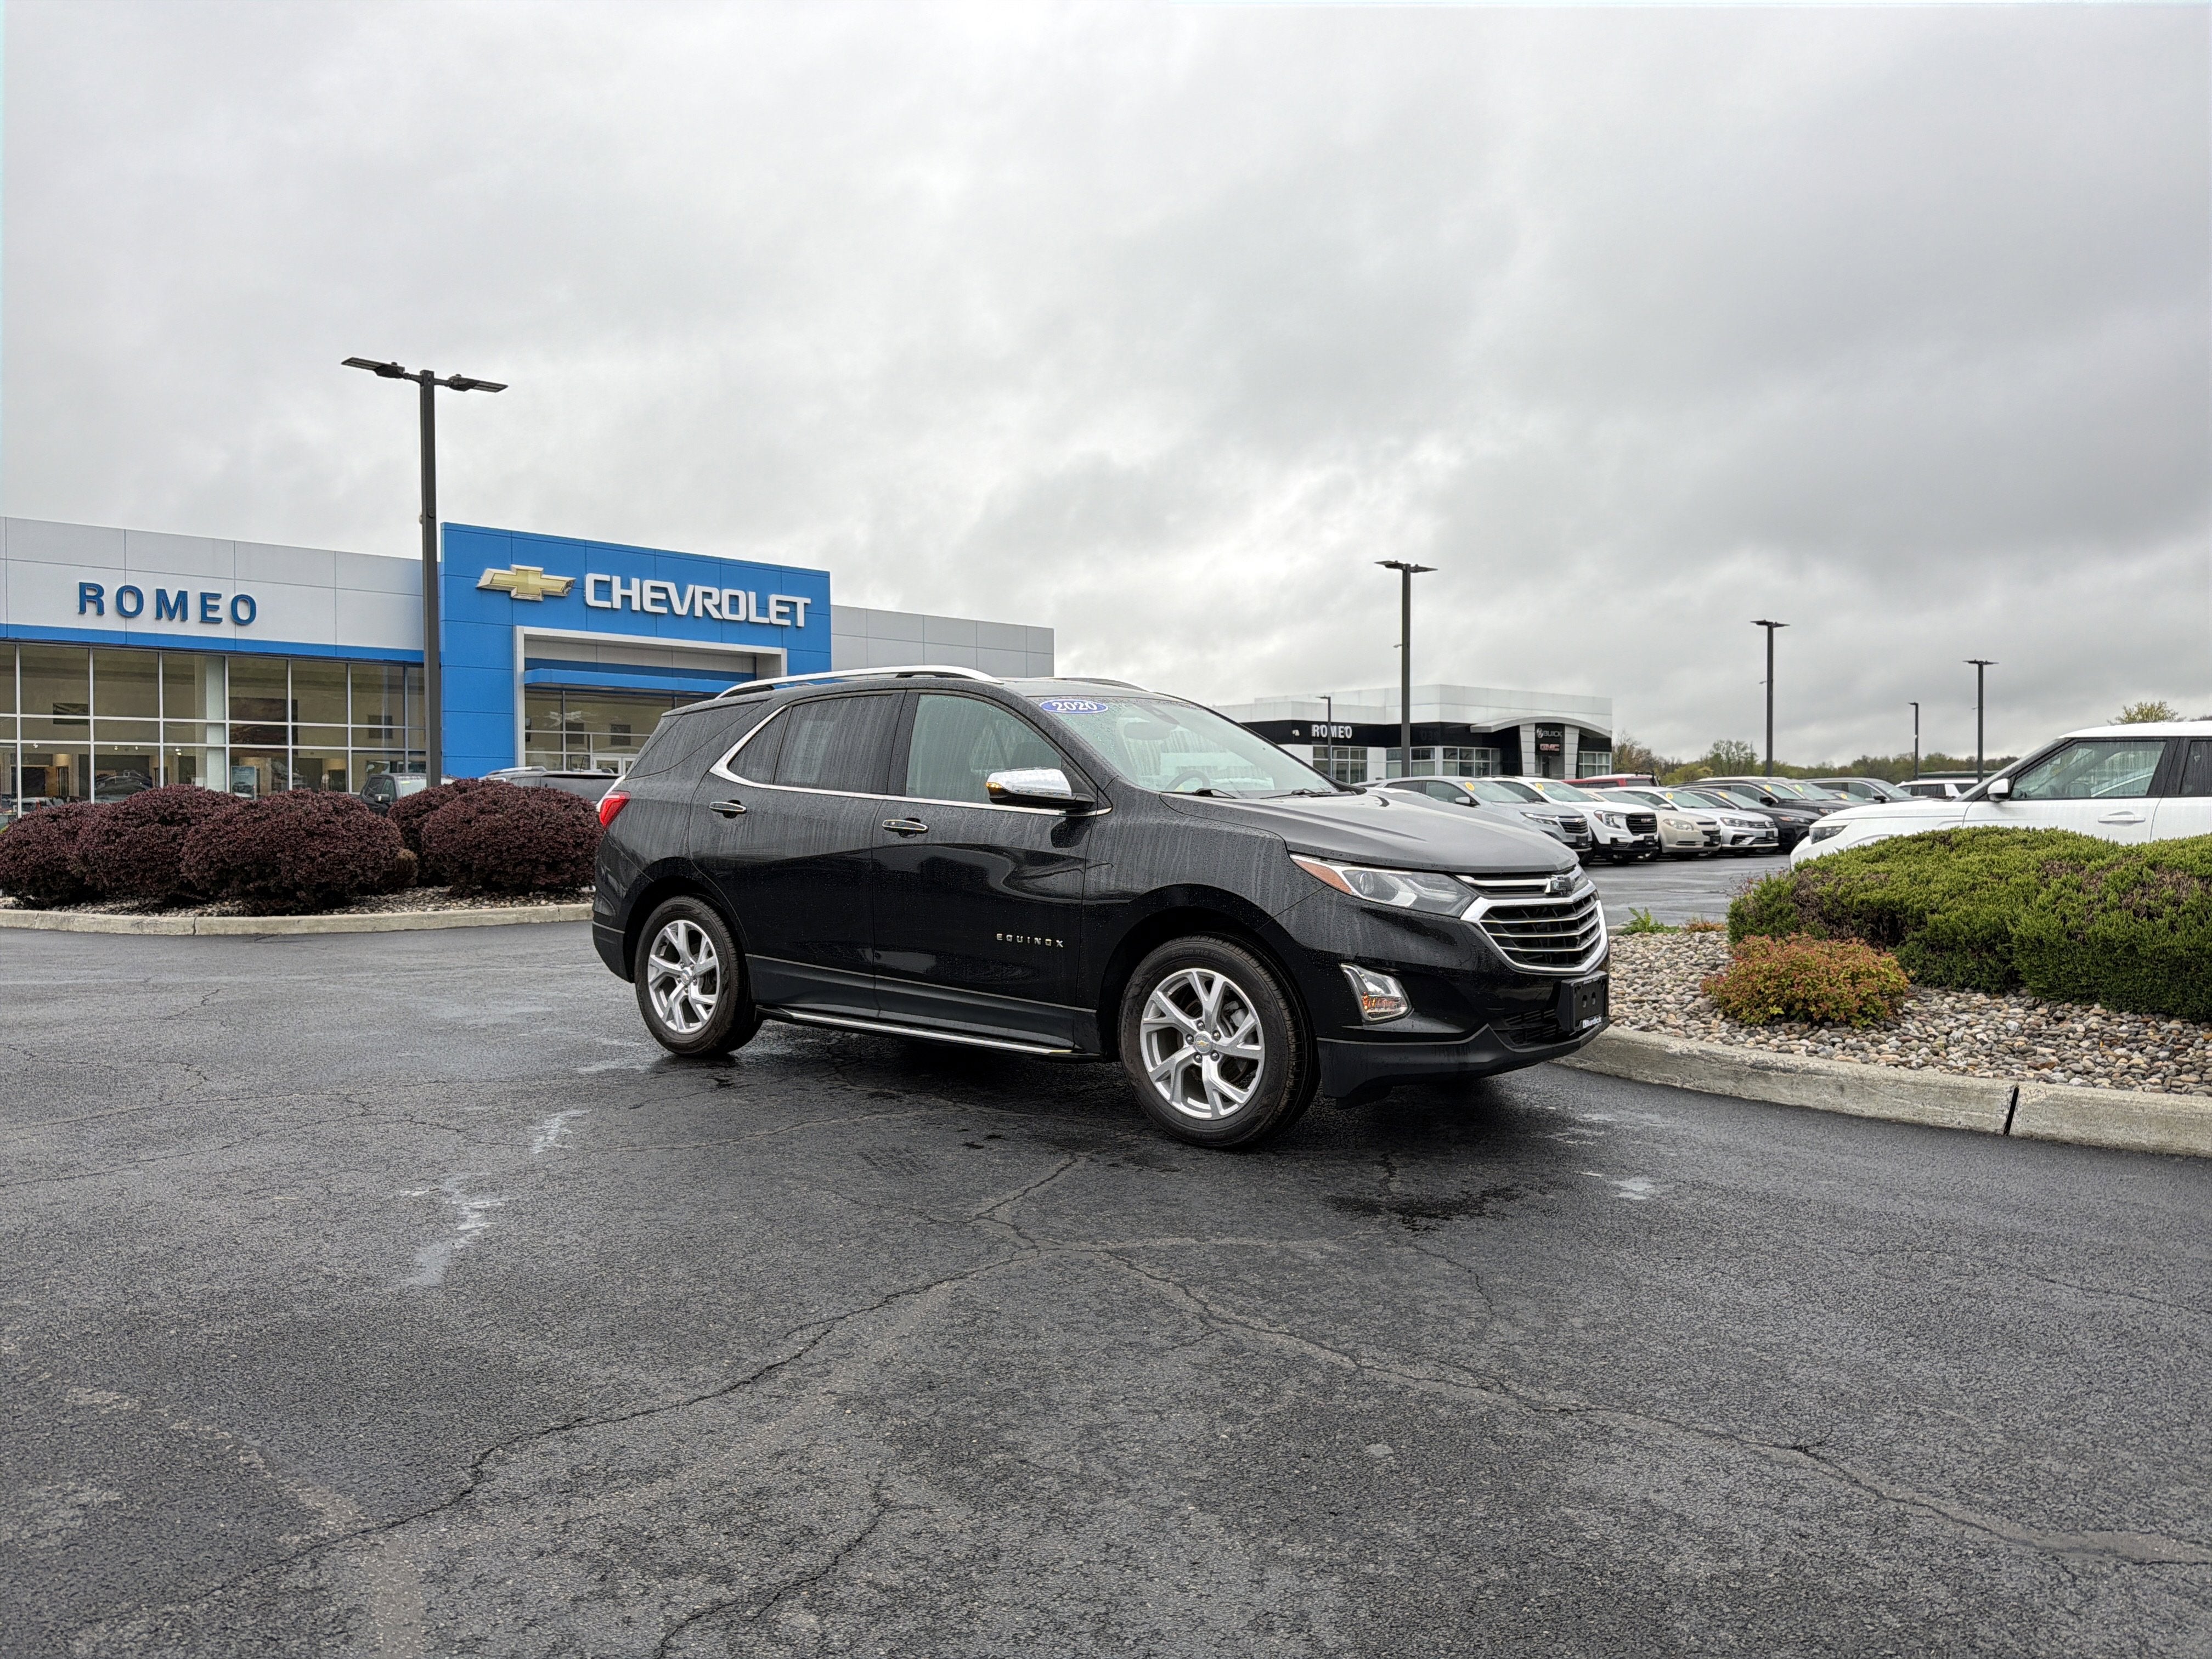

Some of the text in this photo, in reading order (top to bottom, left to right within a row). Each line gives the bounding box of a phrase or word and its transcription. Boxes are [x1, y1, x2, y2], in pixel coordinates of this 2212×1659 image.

[78, 582, 257, 625] ROMEO
[585, 573, 811, 627] CHEVROLET
[1052, 702, 1098, 711] 2020
[1311, 724, 1352, 739] ROMEO
[1539, 743, 1560, 752] GMC
[996, 933, 1064, 948] EQUINOX
